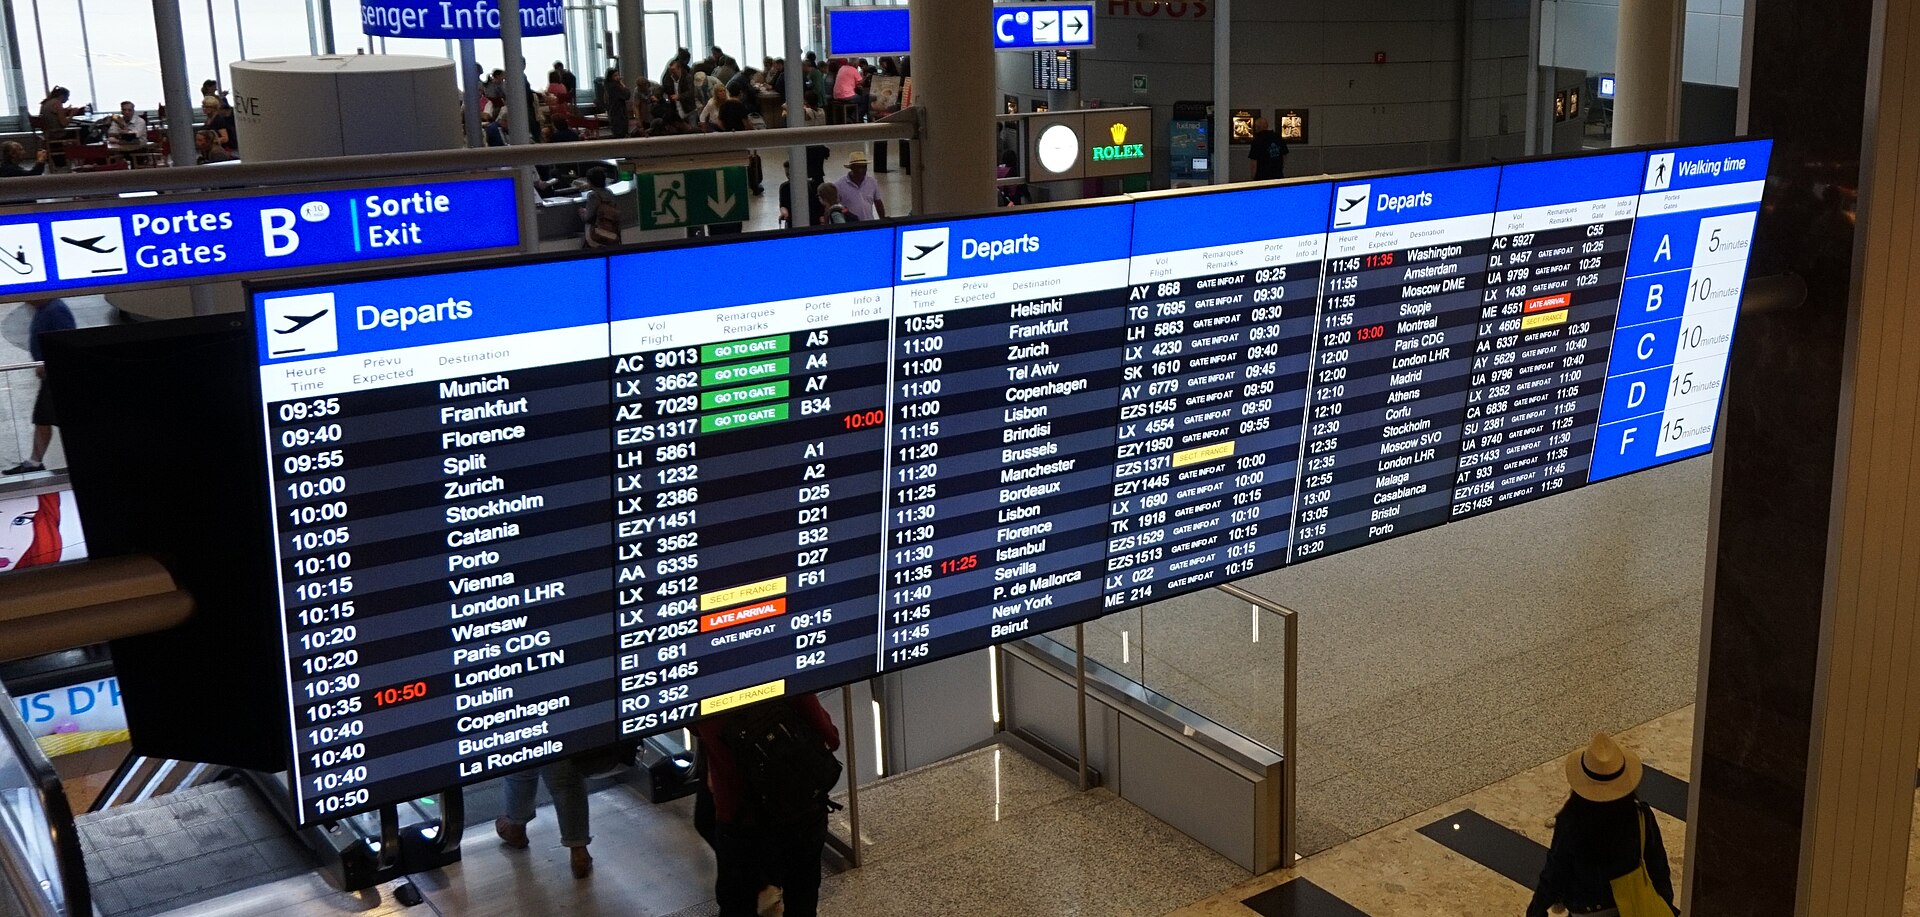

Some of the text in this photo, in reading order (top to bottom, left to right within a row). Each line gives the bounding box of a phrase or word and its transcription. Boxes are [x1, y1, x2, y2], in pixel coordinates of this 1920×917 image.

[996, 14, 1014, 42] C
[1092, 144, 1144, 160] ROLEX
[1680, 157, 1746, 176] Walking time
[366, 191, 449, 217] Sortie
[1377, 191, 1432, 212] Departs
[132, 210, 232, 236] Portes
[261, 208, 299, 256] B
[370, 223, 421, 247] Exit
[962, 234, 1039, 260] Departs
[1333, 224, 1604, 272] 11:45 11:35 Washington AC 5927 C55
[1654, 234, 1670, 262] A
[1708, 229, 1722, 253] 5
[136, 243, 226, 268] Gates
[910, 286, 938, 298] Heure
[1012, 276, 1062, 292] Destination
[1690, 278, 1712, 302] 10
[805, 300, 832, 311] Porte
[853, 295, 873, 306] Info
[905, 267, 1286, 332] 10:55 Helsinki AY 868 GATE INFO AT 09:25
[954, 291, 996, 305] Expected
[1646, 284, 1663, 311] B
[357, 298, 472, 331] Departs
[716, 307, 776, 323] Remarques
[806, 312, 830, 323] Gate
[852, 306, 882, 318] Info at
[1324, 331, 1350, 346] 12:00
[1358, 326, 1384, 340] 13:00
[1397, 316, 1438, 333] Montreal
[1482, 306, 1497, 318] ME
[1502, 302, 1522, 314] 4551
[641, 333, 674, 346] Flight
[648, 322, 666, 332] Vol
[723, 320, 768, 335] Remarks
[1682, 325, 1702, 351] 10
[438, 348, 510, 366] Destination
[1638, 333, 1655, 360] C
[286, 364, 326, 378] Heure
[363, 356, 402, 369] Prévu
[902, 325, 1280, 397] 11:00 Tel Aviv LX 4230 GATE INFO AT 09:30
[280, 330, 828, 421] 09:35 Munich AC 9013 GO TO GATE A5
[291, 379, 324, 392] Time
[353, 368, 414, 384] Expected
[1672, 372, 1694, 397] 15
[1313, 420, 1339, 436] 12:30
[1386, 406, 1411, 420] Corfu
[1470, 390, 1482, 402] LX
[1488, 385, 1510, 398] 2352
[1517, 382, 1531, 390] GATE
[1560, 370, 1581, 383] 11:00
[1628, 382, 1645, 408] D
[1620, 428, 1637, 454] F
[1662, 418, 1684, 443] 15
[290, 410, 884, 524] 10:00 Zurich LH 5861 10:00
[897, 505, 935, 523] 11:30
[1000, 482, 1060, 502] Bordeaux
[1116, 461, 1141, 477] EZS
[1144, 455, 1170, 471] 1371
[1200, 446, 1228, 457] FRANCE
[1302, 506, 1328, 522] 13:05
[1374, 484, 1426, 504] Casablanca
[1457, 471, 1470, 484] AT
[1476, 466, 1492, 478] 933
[1547, 447, 1568, 461] 11:35
[895, 489, 1261, 584] 11:35 11:25 Istanbul TK 1918 GATE INFO AT 10:15
[305, 674, 360, 698] 10:30
[454, 644, 501, 665] Paris
[506, 631, 550, 652] CDG
[620, 609, 643, 626] LX
[657, 598, 698, 617] 4604
[740, 582, 778, 597] FRANCE
[799, 569, 824, 587] F61
[307, 604, 776, 721] 10:35 10:50 London LTN EZY 2052 LATE ARRIVAL
